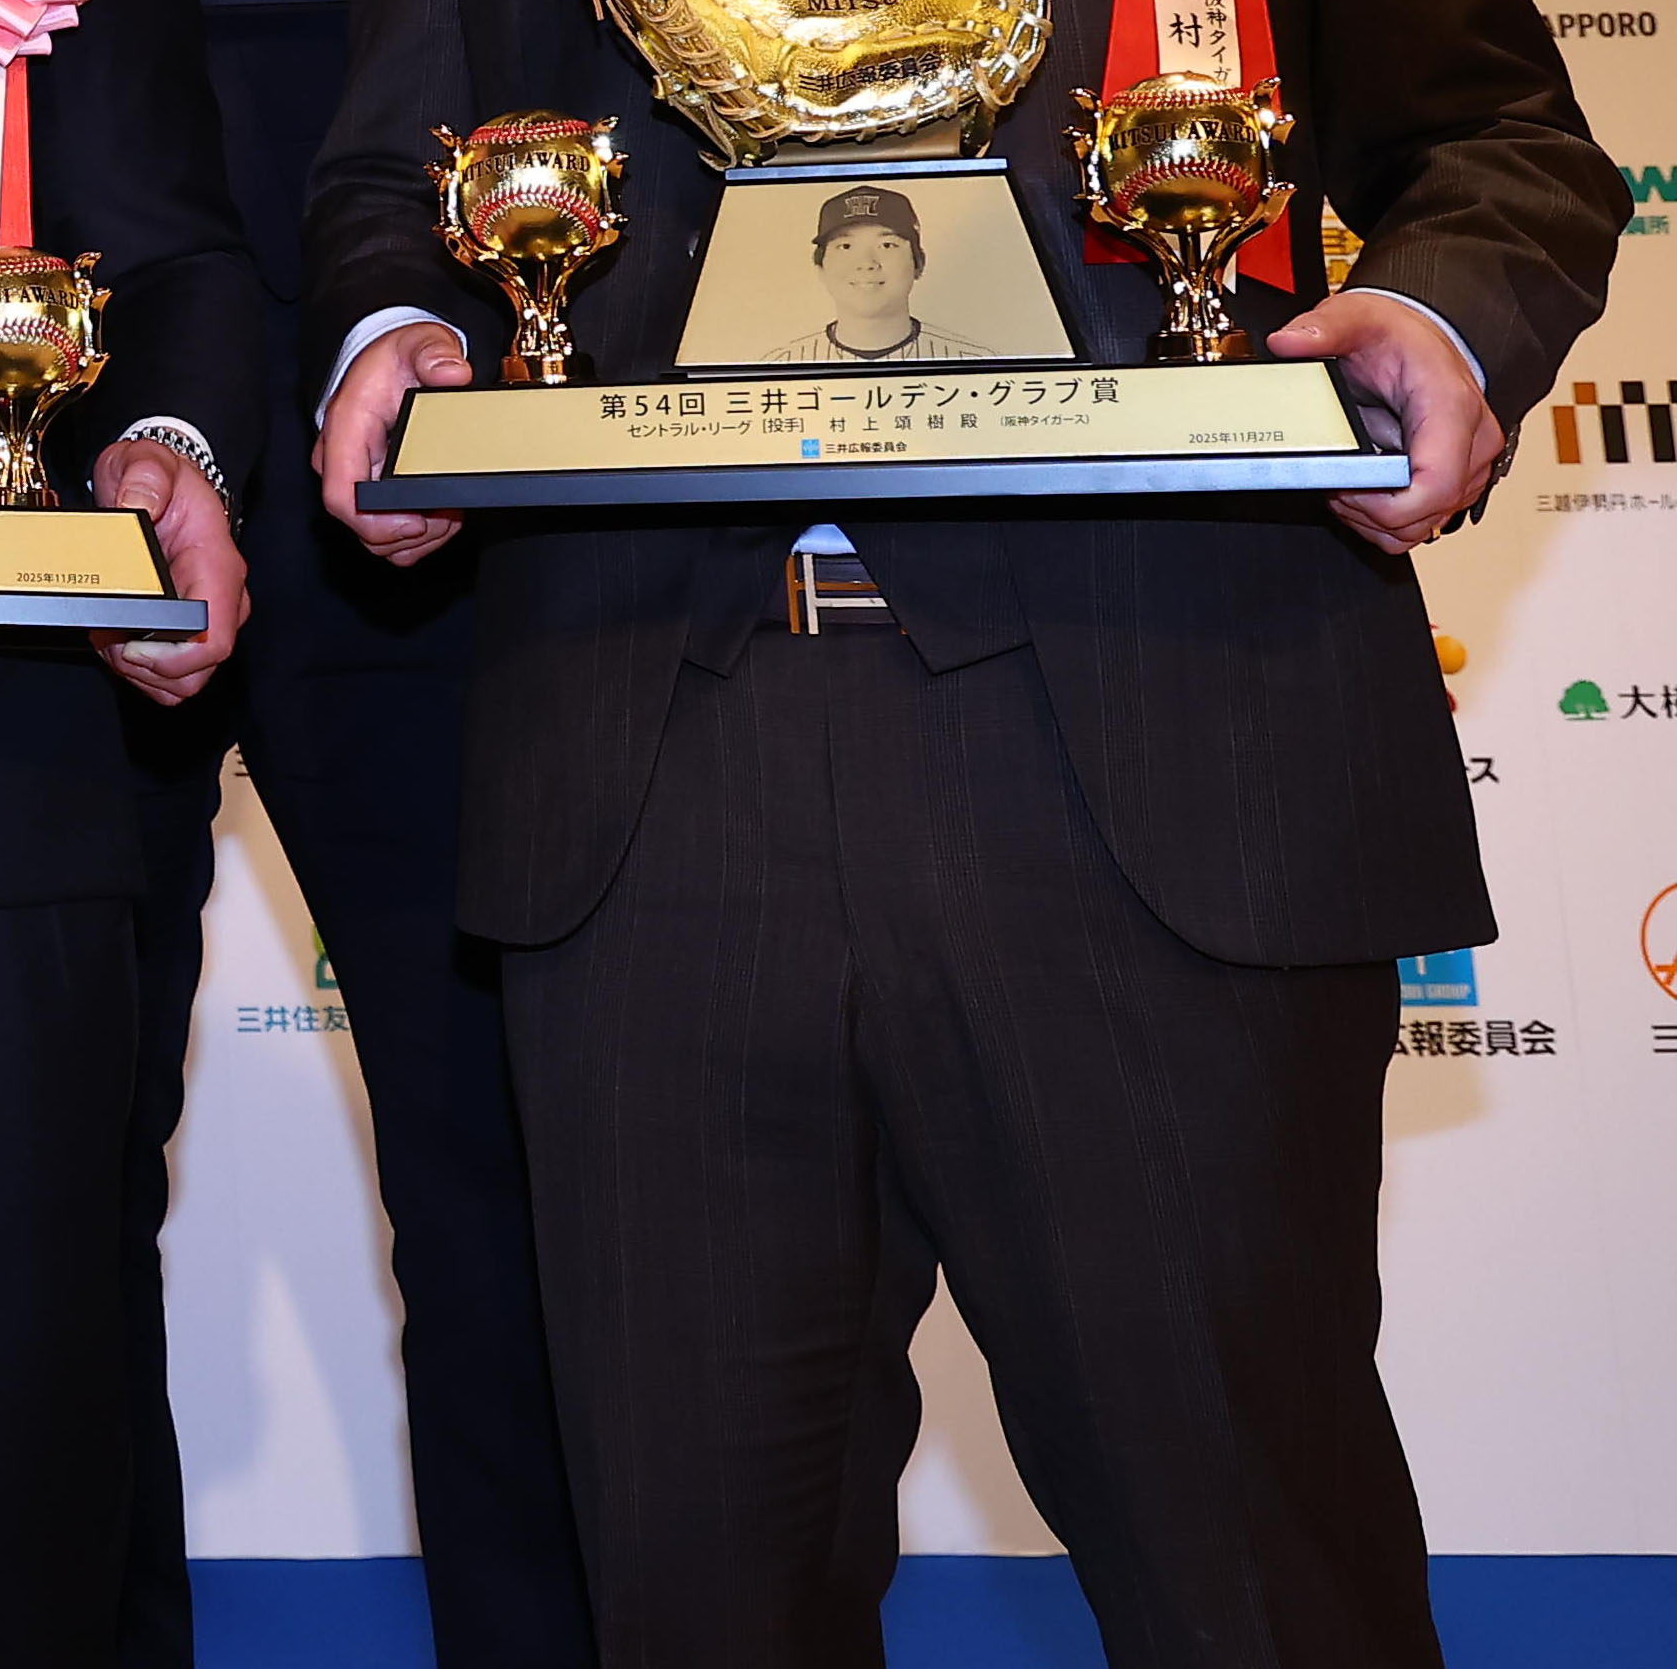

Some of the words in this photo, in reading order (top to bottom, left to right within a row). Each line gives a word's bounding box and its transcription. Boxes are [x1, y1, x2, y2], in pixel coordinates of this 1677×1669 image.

[1108, 121, 1181, 152] MITSUI
[1191, 119, 1258, 144] AWARD
[524, 151, 591, 173] AWARD
[20, 286, 81, 310] AWARD
[599, 392, 706, 420] 第54回
[726, 376, 1120, 415] 三井ゴールデン・グラブ賞
[627, 419, 751, 439] セントラル・リーグ
[828, 412, 979, 433] 村上頌樹殿
[1188, 430, 1285, 444] 2025年11月27日
[16, 572, 100, 585] 2025年11月27日
